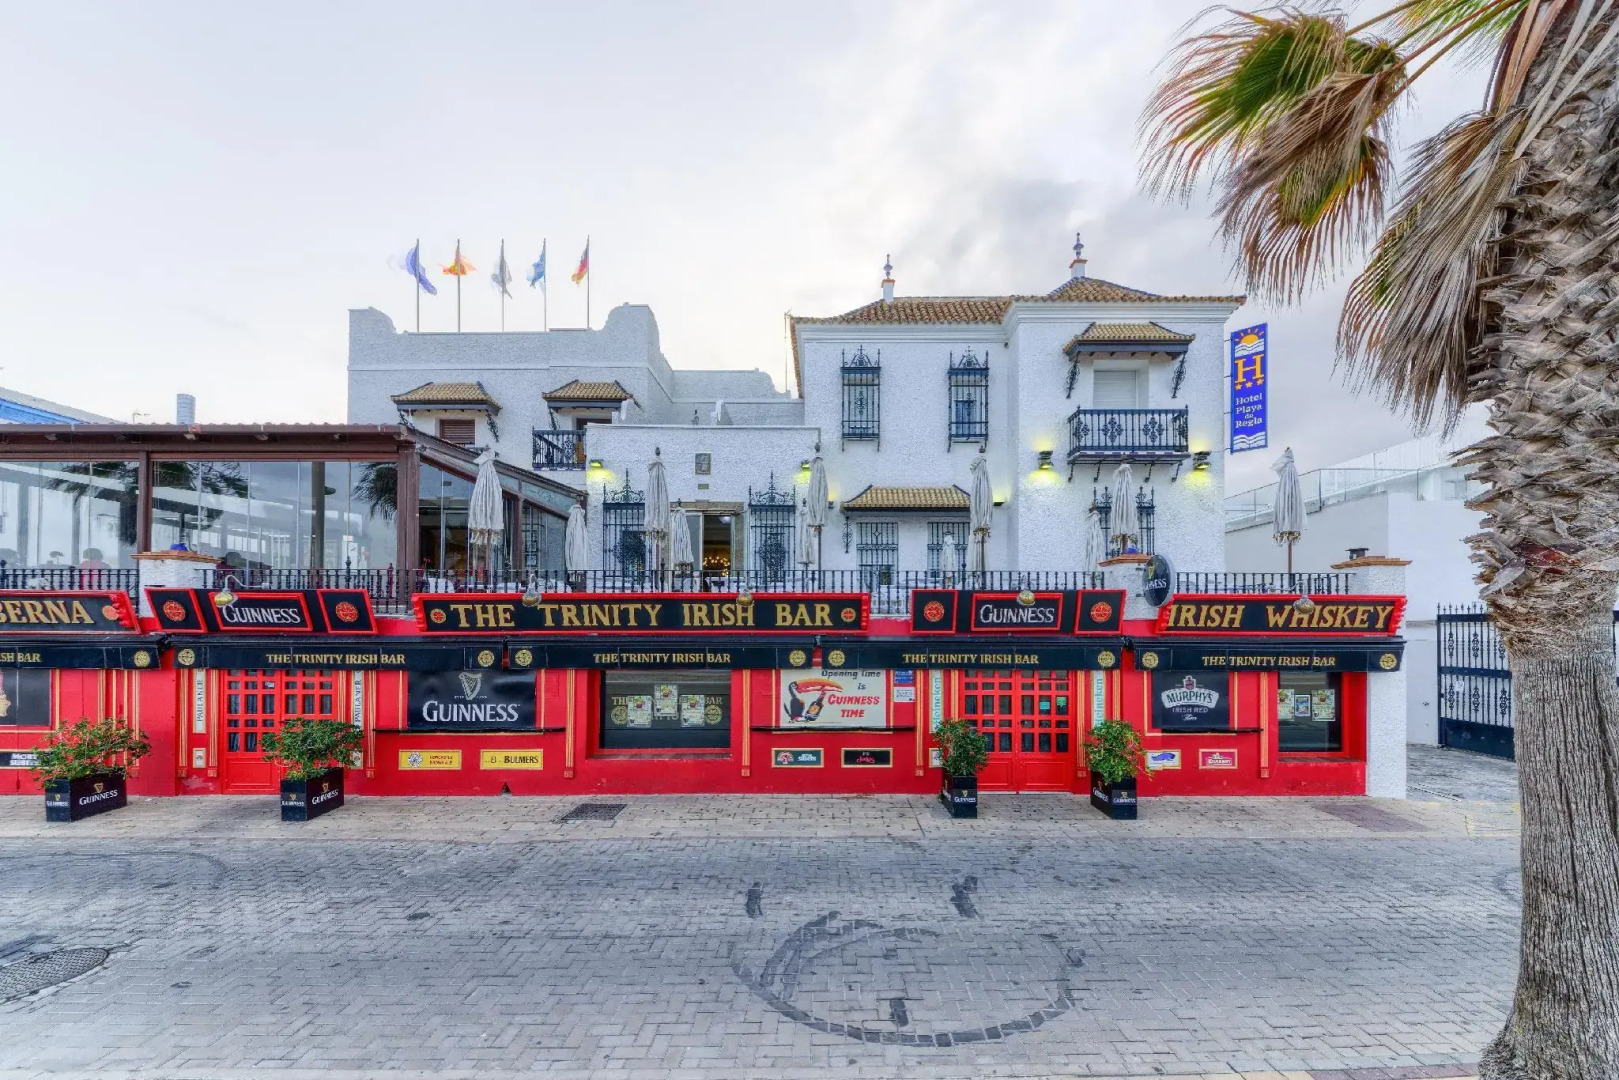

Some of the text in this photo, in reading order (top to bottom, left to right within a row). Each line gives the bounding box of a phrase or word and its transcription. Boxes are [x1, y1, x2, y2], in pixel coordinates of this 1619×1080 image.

[1234, 353, 1265, 384] H
[1235, 392, 1263, 406] Hotel
[1236, 404, 1263, 415] Playa
[1235, 416, 1263, 429] Regla
[222, 605, 301, 624] GUINNESS
[450, 603, 834, 627] THE TRINITY IRISH BAR
[979, 604, 1055, 624] GUINNESS
[1167, 604, 1395, 629] IRISH WHISKEY
[17, 652, 43, 663] BAR
[266, 653, 406, 664] THE TRINITY IRISH BAR
[593, 653, 731, 664] THE TRINITY IRISH BAR
[902, 653, 1039, 664] THE TRINITY IRISH BAR
[1202, 655, 1336, 666] THE TRINITY IRISH BAR
[821, 670, 881, 680] Opening Time
[827, 693, 880, 706] GUINNESS
[422, 700, 519, 722] GUINNESS
[840, 709, 865, 718] TIME
[503, 755, 539, 764] BULMERS
[79, 789, 119, 805] GUINNESS
[311, 789, 339, 805] GUINNESS
